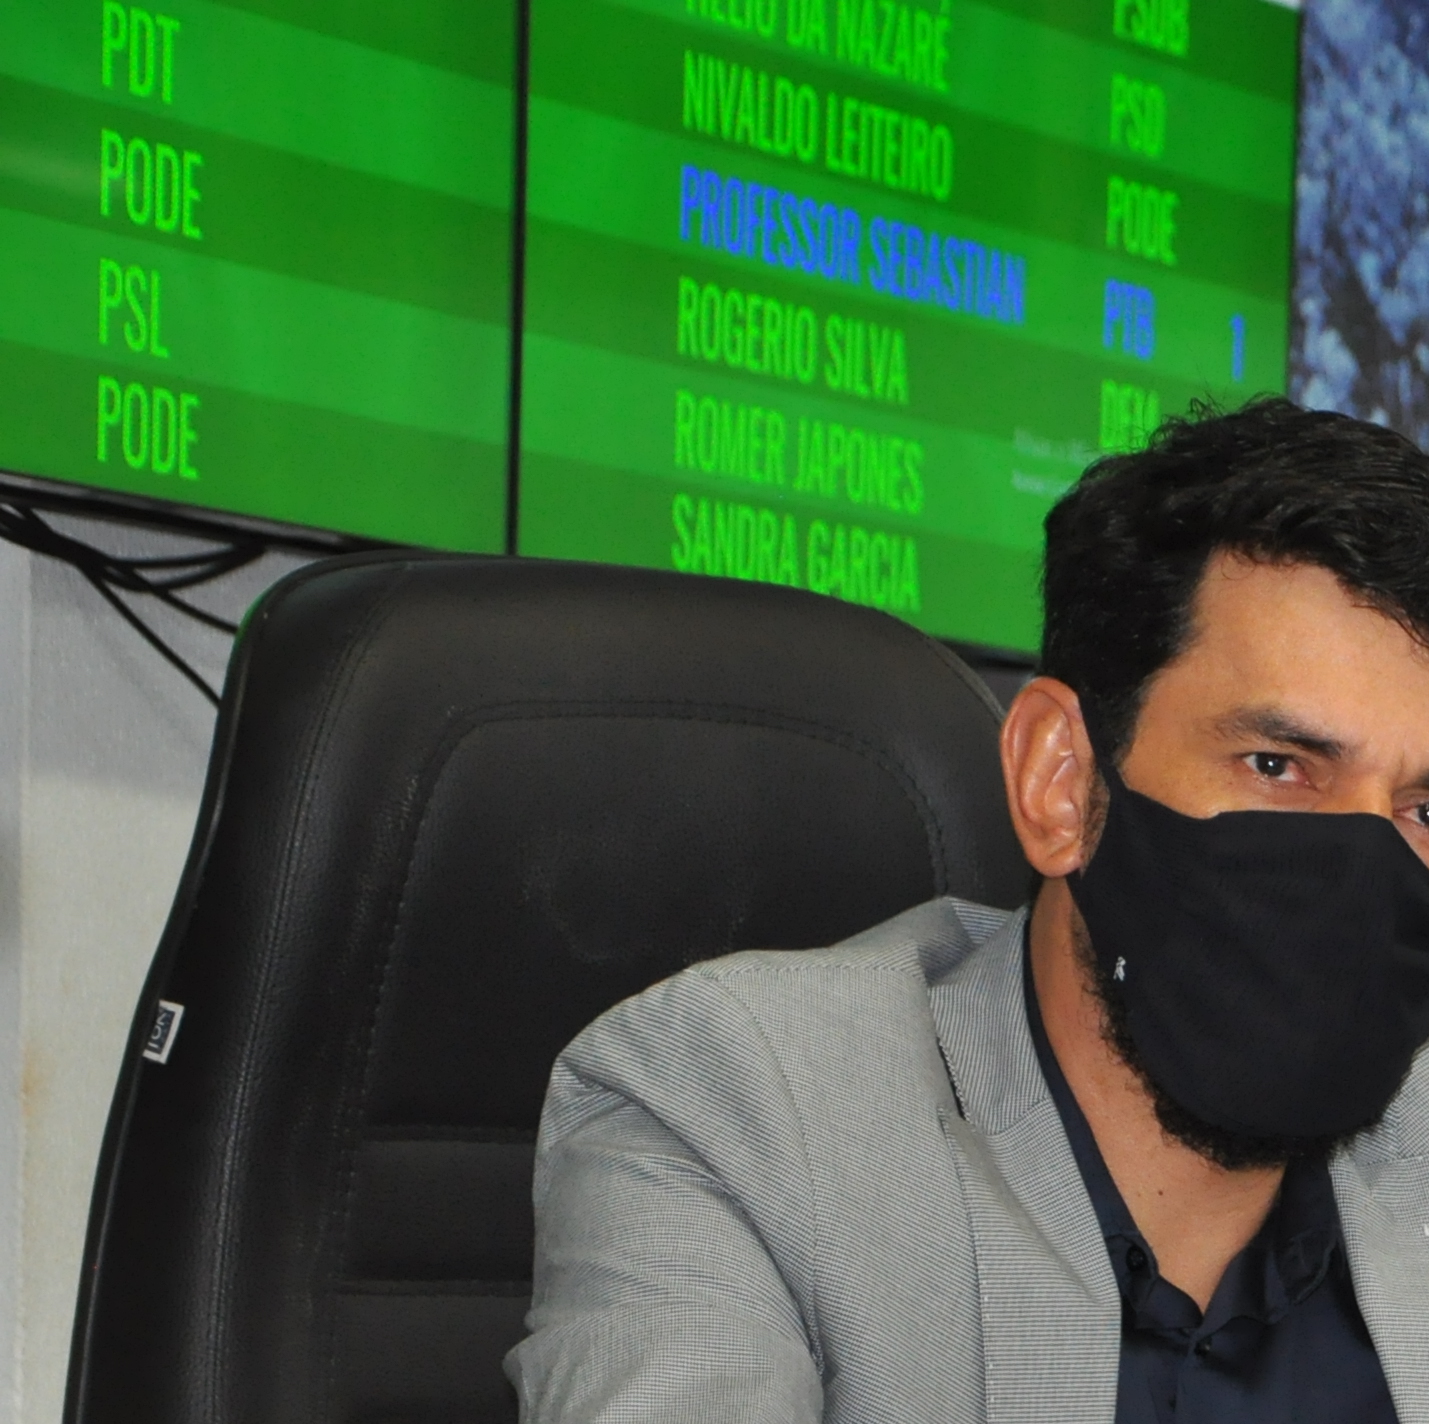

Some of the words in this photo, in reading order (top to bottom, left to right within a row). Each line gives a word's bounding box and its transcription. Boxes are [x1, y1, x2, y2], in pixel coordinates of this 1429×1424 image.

[102, 2, 179, 104] PDT
[683, 49, 818, 165] NIVALDO
[825, 91, 953, 202] LEITEIRO
[100, 128, 203, 241] PODE
[1106, 174, 1181, 268] PODE
[680, 164, 861, 285] PROFESSOR
[868, 215, 1026, 325] SEBASTIAN
[100, 258, 169, 359] PSL
[677, 275, 817, 384] ROGERIO
[824, 314, 909, 405] SILVA
[1103, 277, 1156, 360] PTB
[1230, 313, 1246, 383] 1
[97, 376, 199, 480] PODE
[675, 387, 787, 486] ROMER
[793, 415, 926, 516] JAPONES
[672, 492, 799, 587] SANDRA
[807, 519, 922, 614] GARCIA
